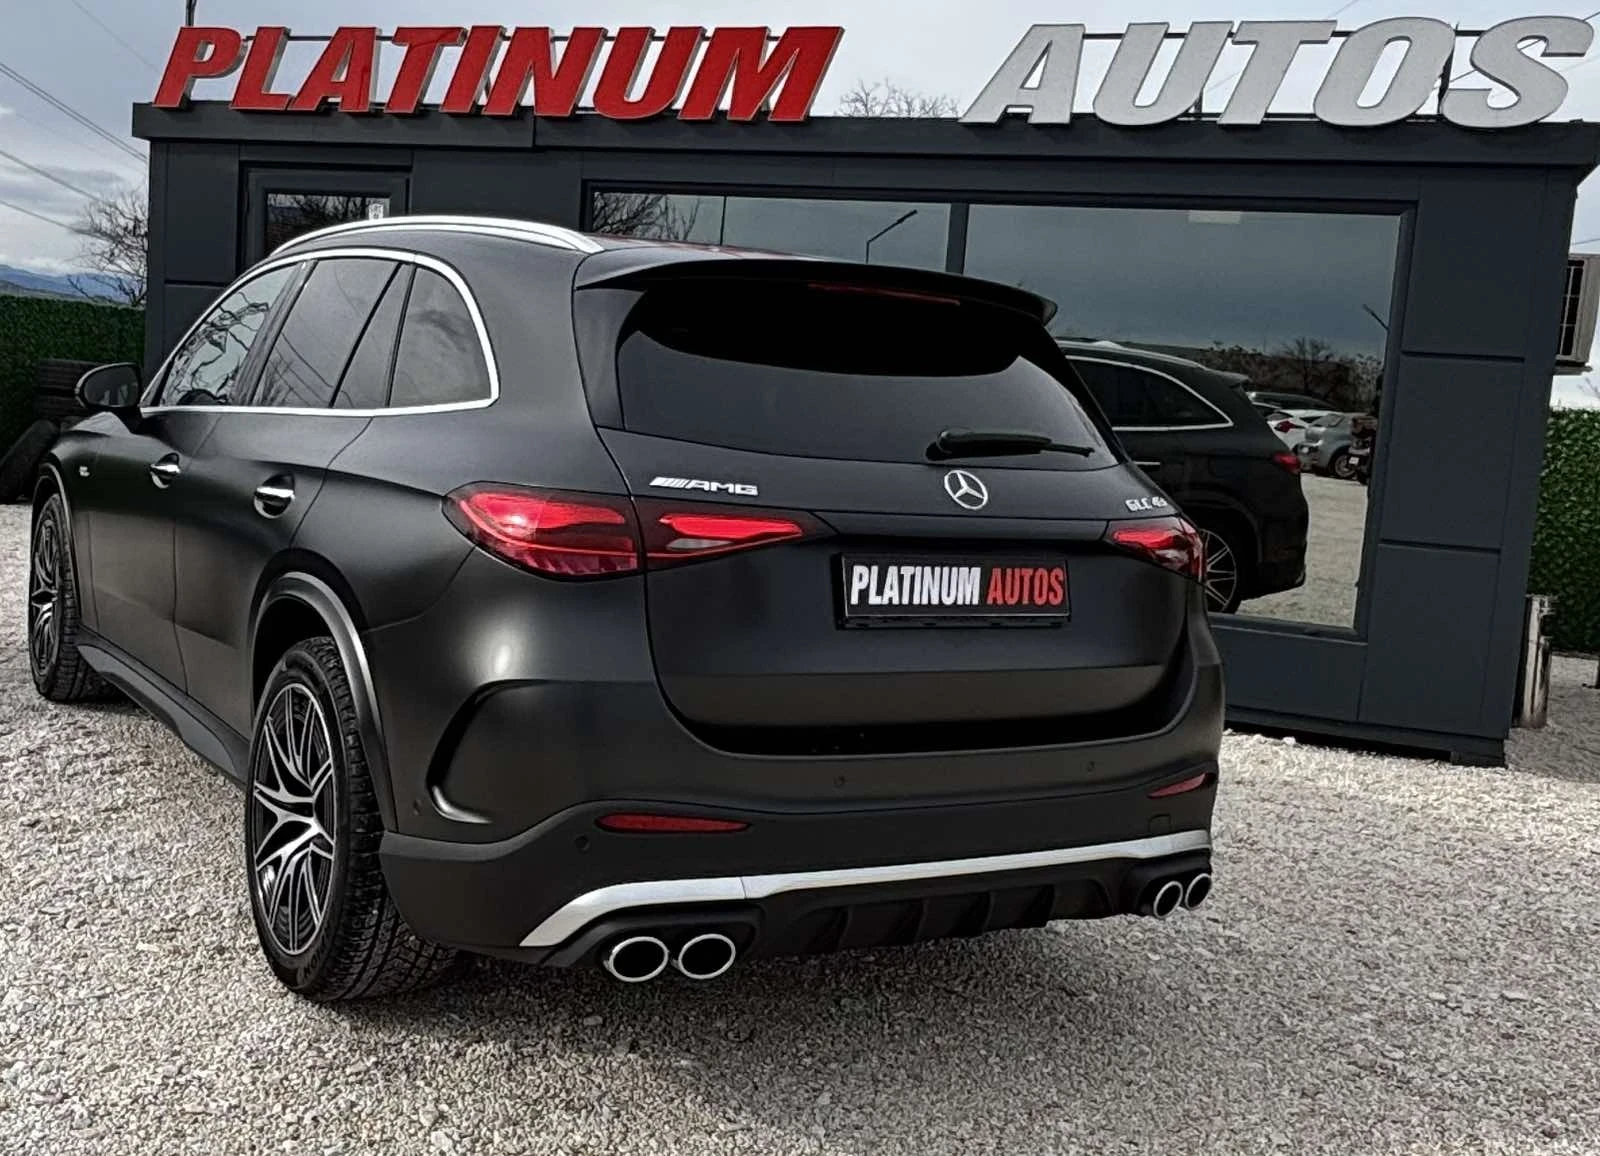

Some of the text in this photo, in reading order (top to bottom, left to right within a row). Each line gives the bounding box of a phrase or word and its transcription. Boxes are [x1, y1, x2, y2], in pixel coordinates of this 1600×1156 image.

[152, 16, 1595, 128] PLATINUM AUTOS
[685, 478, 759, 496] AMG
[850, 565, 1065, 608] PLATINUM AUTOS
